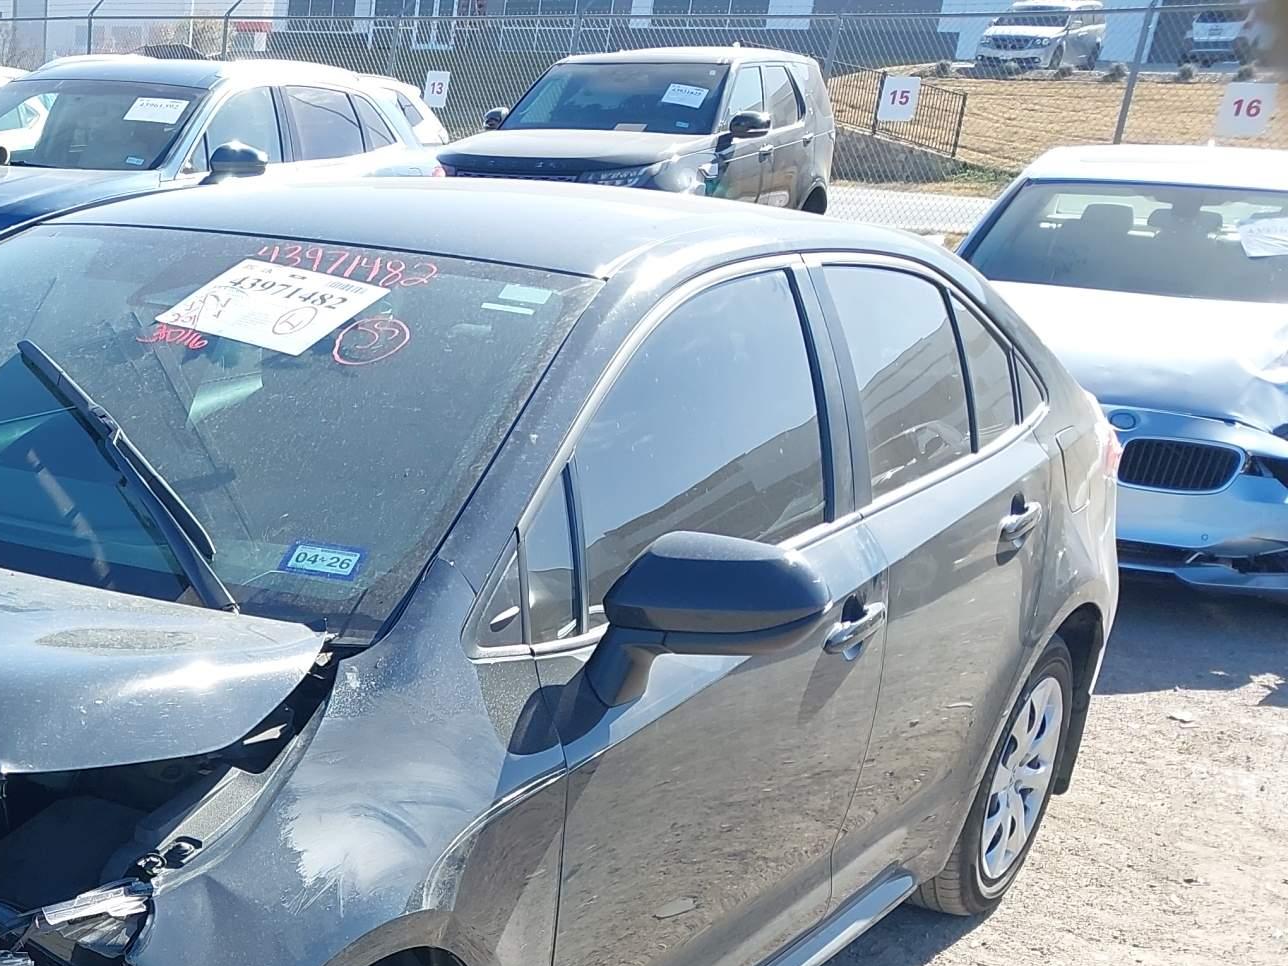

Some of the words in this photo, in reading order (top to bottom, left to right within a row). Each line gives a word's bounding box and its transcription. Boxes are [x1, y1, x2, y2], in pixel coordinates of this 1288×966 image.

[431, 82, 443, 95] 13
[890, 90, 910, 105] 15
[1233, 99, 1262, 117] 16
[258, 245, 438, 287] 43971482
[229, 275, 348, 310] 43971482
[295, 551, 319, 565] 04
[326, 556, 352, 570] 26
